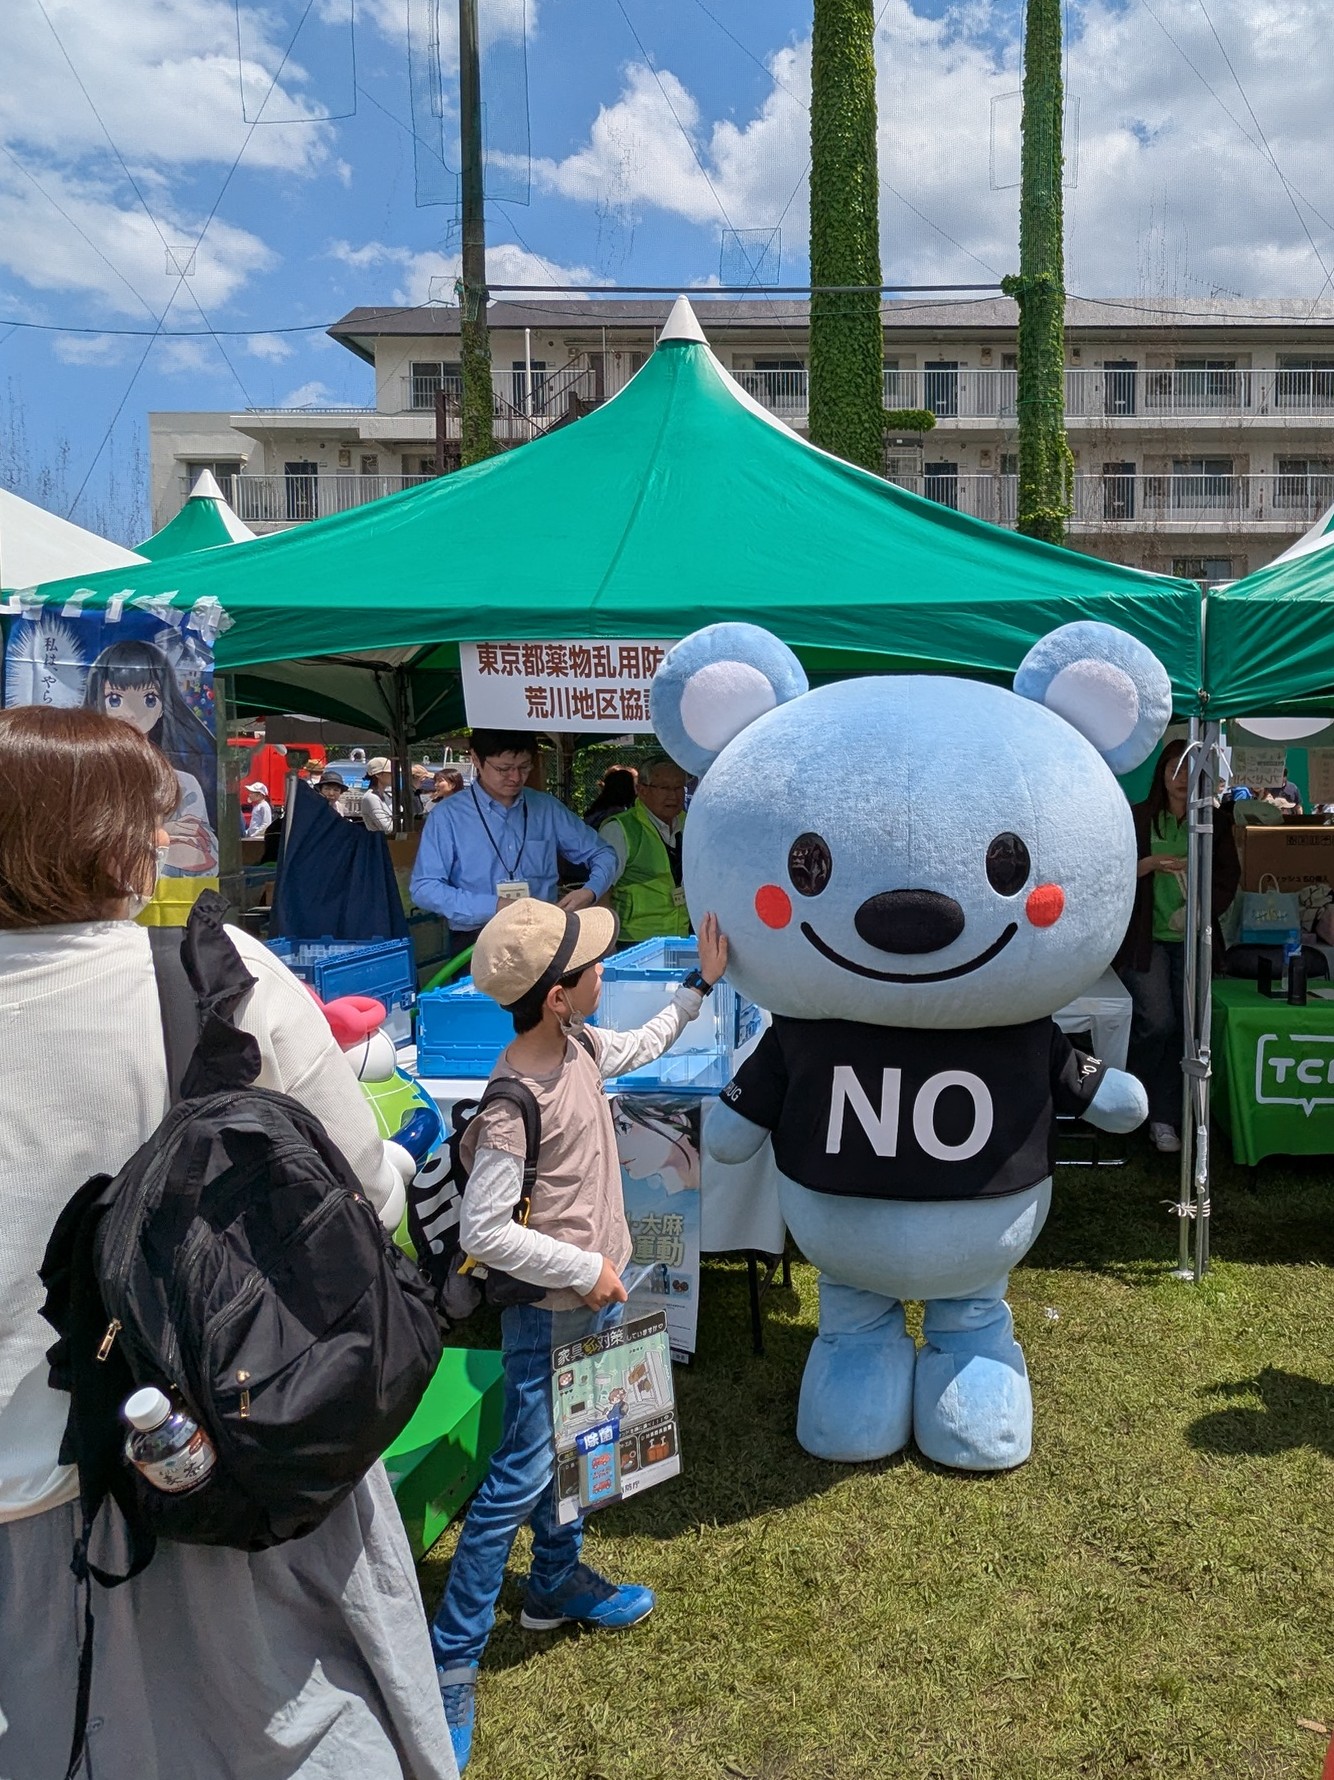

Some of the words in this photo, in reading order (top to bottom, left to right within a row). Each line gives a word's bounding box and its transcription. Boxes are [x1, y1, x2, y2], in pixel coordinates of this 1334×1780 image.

[476, 642, 665, 680] 東京都薬物乱用防
[825, 1065, 994, 1162] NO
